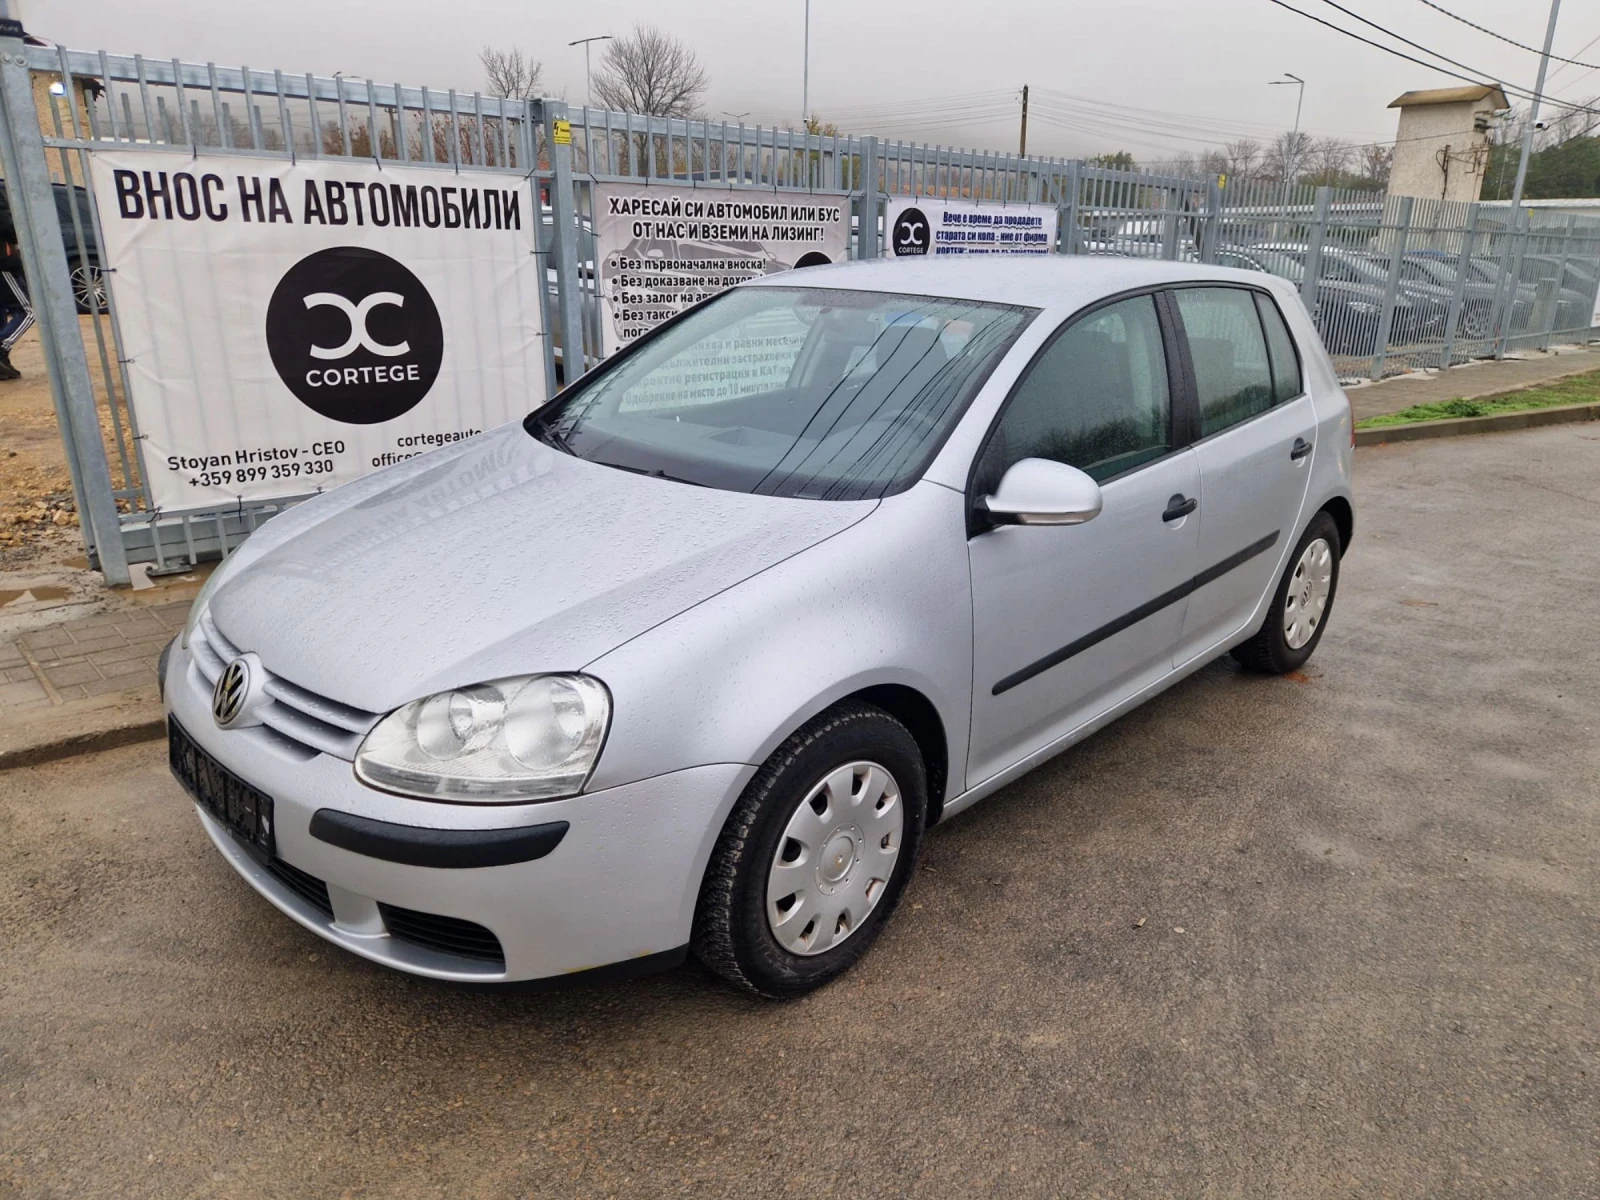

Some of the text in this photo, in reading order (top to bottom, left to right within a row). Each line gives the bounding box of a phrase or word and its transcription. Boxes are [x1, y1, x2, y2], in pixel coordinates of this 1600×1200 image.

[113, 169, 521, 230] ВНОС НА АВТОМОБИЛИ
[609, 197, 840, 222] ХАРЕСАЙ СИ АВТОМОБИЛ ИЛИ БУС
[943, 211, 1042, 226] Вече е време да продадете
[633, 221, 824, 241] ОТ НАС И ВЗЕМИ НА ЛИЗИНГ!
[935, 230, 966, 241] старата
[967, 231, 977, 241] си
[978, 231, 995, 241] кола
[1000, 232, 1014, 242] ние
[1015, 232, 1023, 242] от
[1024, 232, 1048, 243] фирма
[620, 257, 767, 272] Без първоначална вноска!
[621, 274, 642, 287] Без
[645, 276, 705, 289] доказване
[707, 276, 720, 286] на
[621, 291, 643, 304] Без
[646, 293, 678, 303] залог
[680, 293, 693, 302] на
[622, 309, 644, 321] Без
[623, 328, 649, 338] пог
[305, 364, 420, 387] CORTEGE
[684, 369, 750, 385] регистрация
[730, 383, 739, 395] 10
[167, 454, 232, 471] Stoyan
[235, 448, 298, 465] Hristov
[312, 440, 345, 456] CEO
[189, 459, 334, 487] +359 899 359 330
